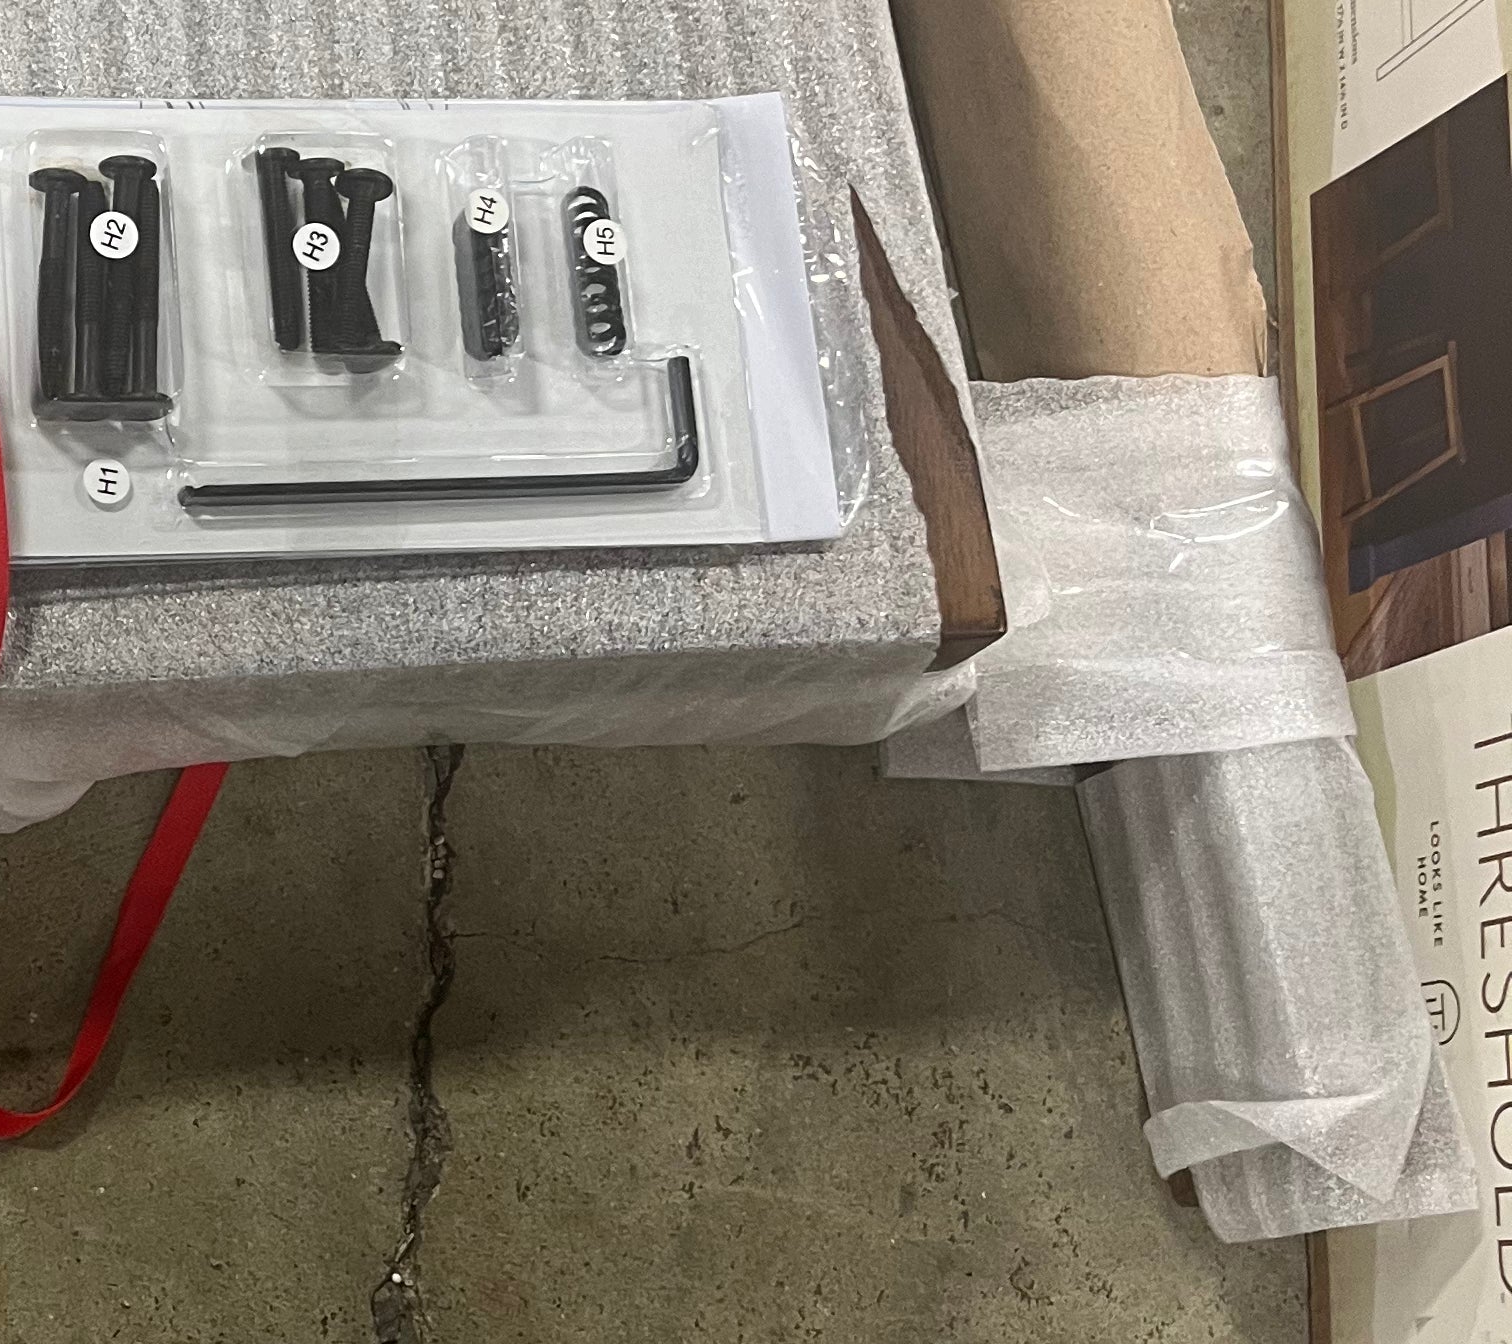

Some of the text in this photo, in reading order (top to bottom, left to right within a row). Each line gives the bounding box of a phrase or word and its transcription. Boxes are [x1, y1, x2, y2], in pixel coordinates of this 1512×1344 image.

[473, 195, 498, 226] H4
[100, 218, 127, 251] H2
[301, 230, 329, 262] H3
[596, 226, 615, 257] H5
[97, 467, 119, 496] H1
[1416, 856, 1429, 919] HOME
[1429, 820, 1444, 948] LOOKS LIKE
